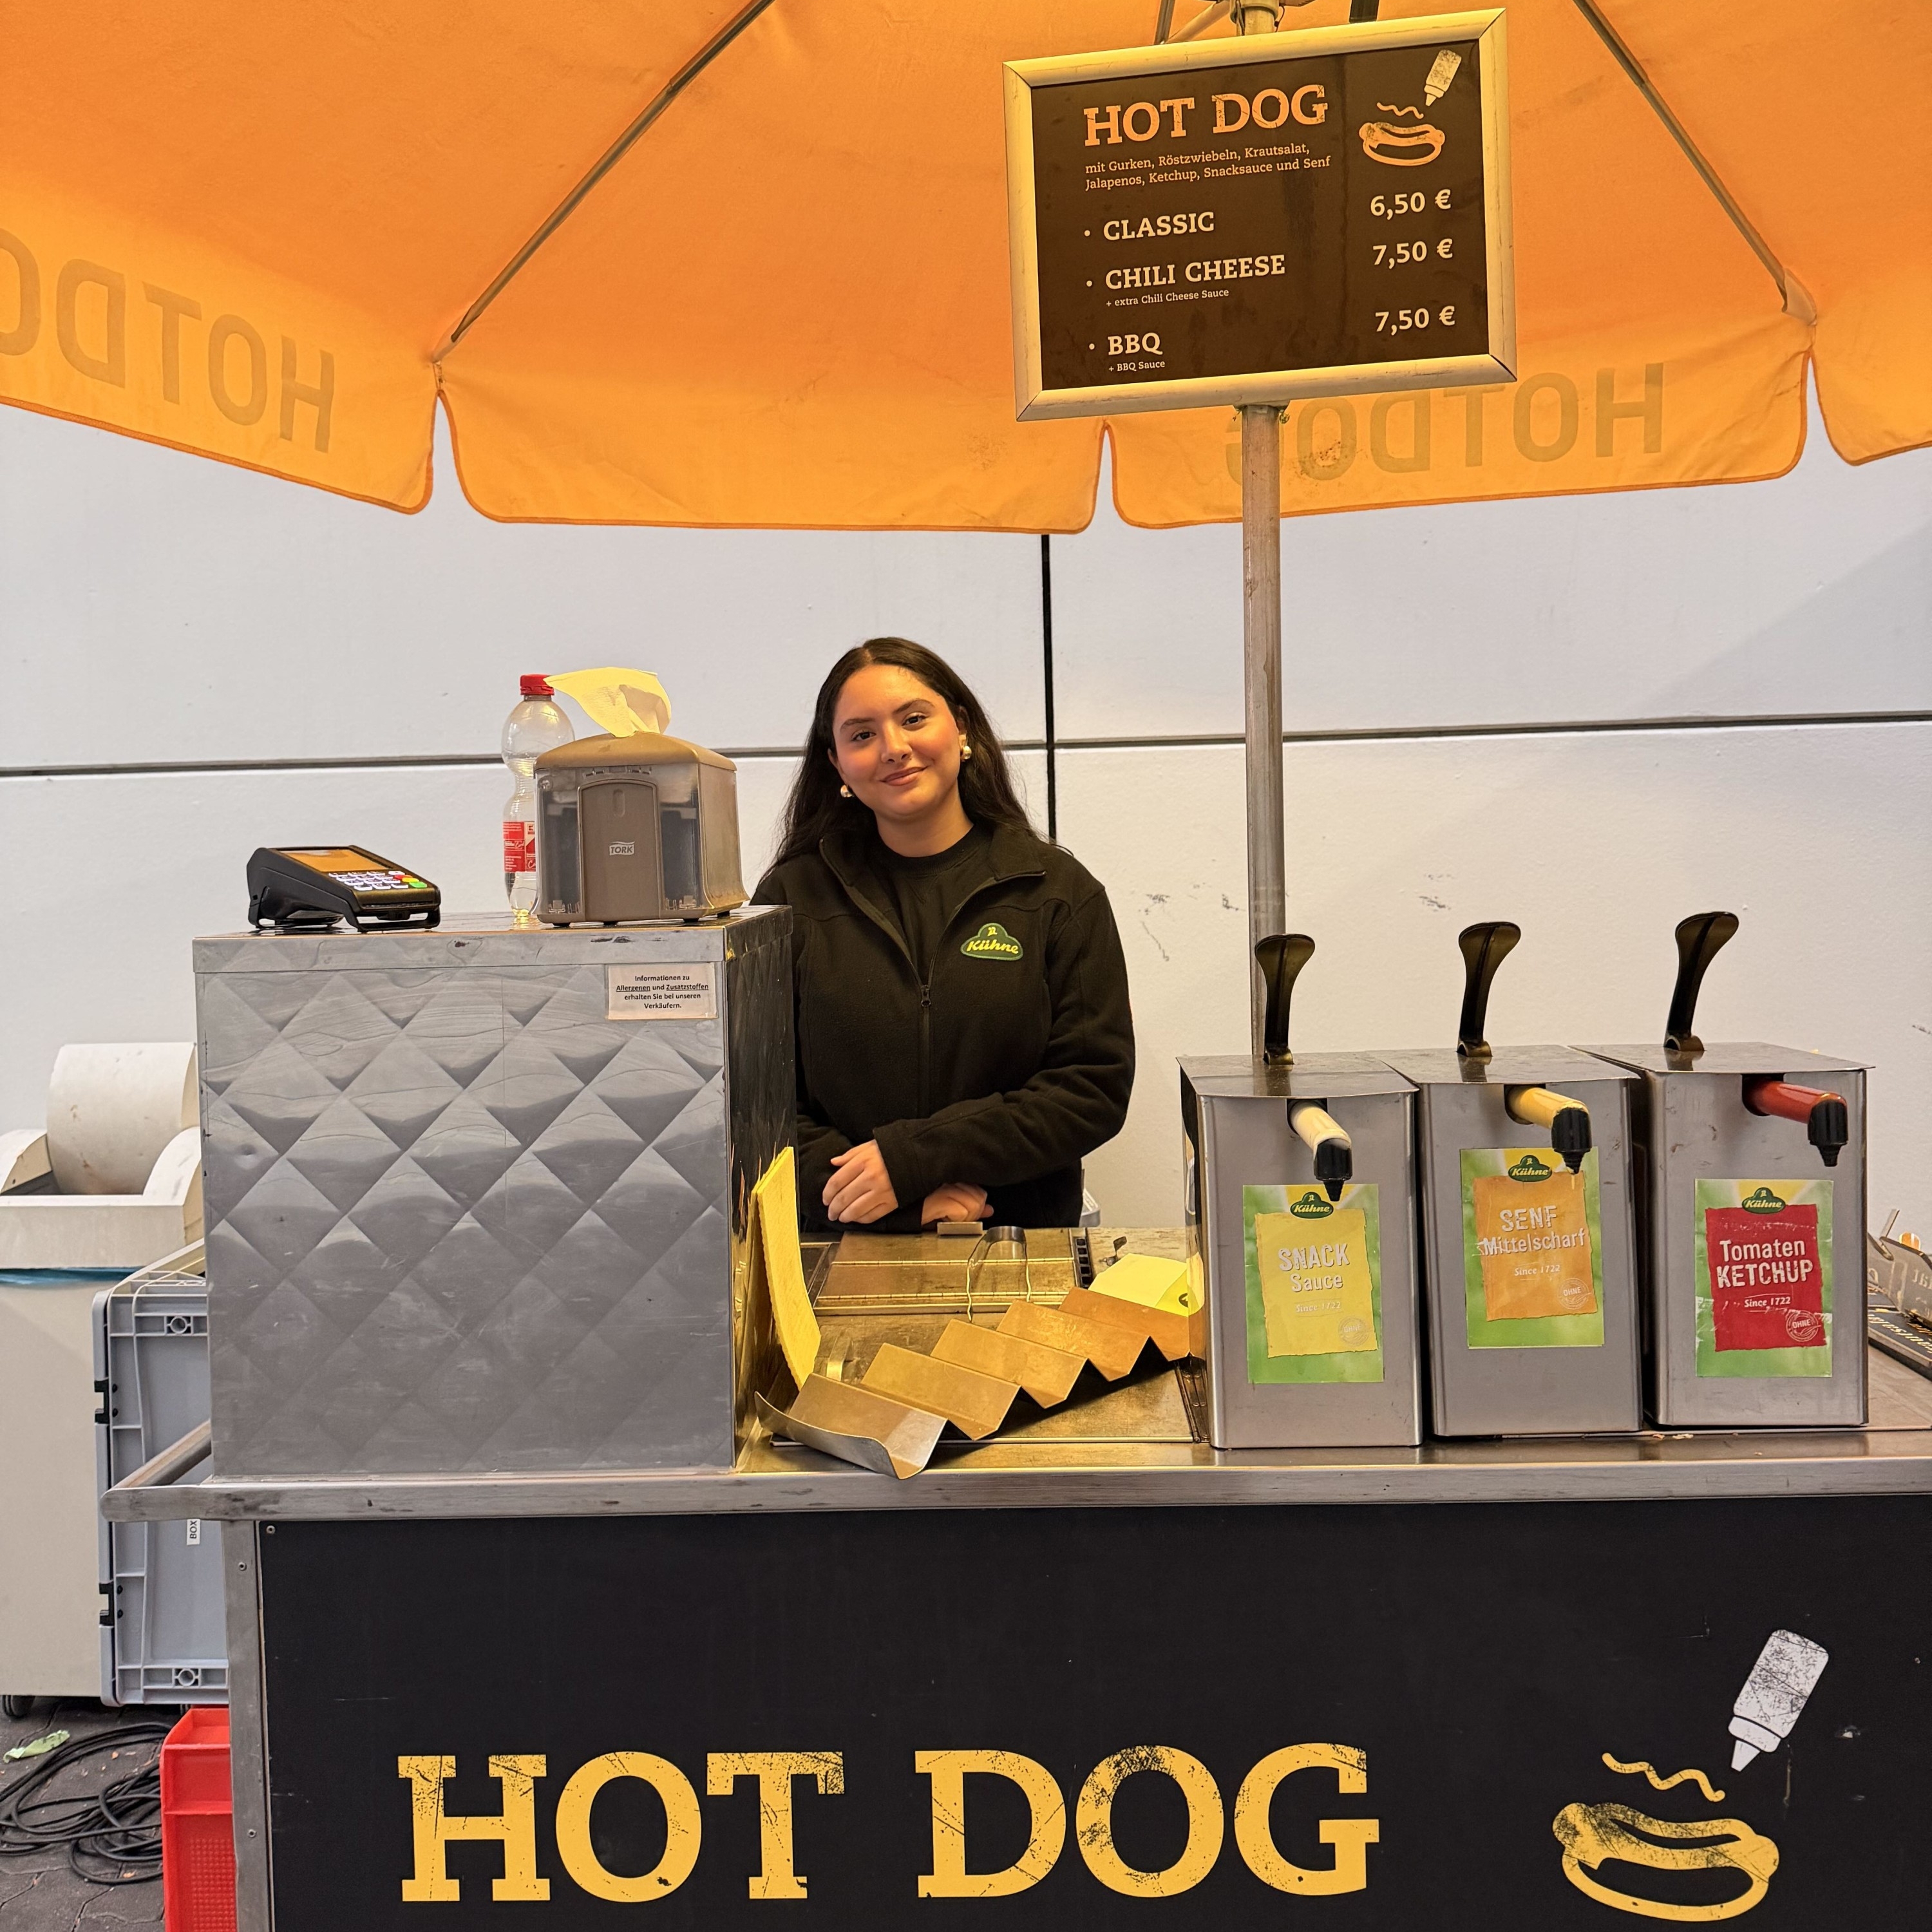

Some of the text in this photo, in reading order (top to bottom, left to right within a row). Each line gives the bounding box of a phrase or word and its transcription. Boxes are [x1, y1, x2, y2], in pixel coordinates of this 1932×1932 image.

[1084, 84, 1328, 147] HOT DOG
[1086, 143, 1310, 174] mit Gurken, Röstzwiebeln, Krautsalat,
[1085, 156, 1331, 191] Jalapenos, Ketchup, Snacksauce und Senf
[1370, 189, 1451, 220] 6,50 €
[1103, 211, 1215, 241] CLASSIC
[1373, 238, 1453, 269] 7,50 €
[1105, 254, 1285, 290] CHILI CHEESE
[1114, 297, 1139, 307] extra
[1141, 294, 1163, 305] Chili
[1166, 291, 1199, 302] Cheese
[1202, 289, 1229, 299] Sauce
[1375, 305, 1455, 336] 7,50 €
[1108, 332, 1163, 355] BBQ
[1117, 362, 1137, 372] BBQ
[1139, 360, 1165, 370] Sauce
[967, 940, 1019, 954] Kühne
[1511, 1167, 1549, 1176] Kühne
[1294, 1204, 1331, 1213] Kühne
[1745, 1199, 1783, 1209] Kühne
[1499, 1205, 1557, 1232] SENF
[1482, 1227, 1586, 1256] Mittelscharf
[1719, 1238, 1806, 1262] Tomaten
[1278, 1243, 1350, 1271] SNACK
[1515, 1264, 1561, 1276] Since 1722
[1716, 1259, 1814, 1288] KETCHUP
[1290, 1273, 1343, 1293] Sauce
[1563, 1286, 1582, 1296] OHNE
[1296, 1301, 1341, 1312] Since 1722
[1744, 1296, 1791, 1308] Since 1722
[1792, 1318, 1812, 1329] OHNE
[397, 1742, 1380, 1903] HOT DOG
